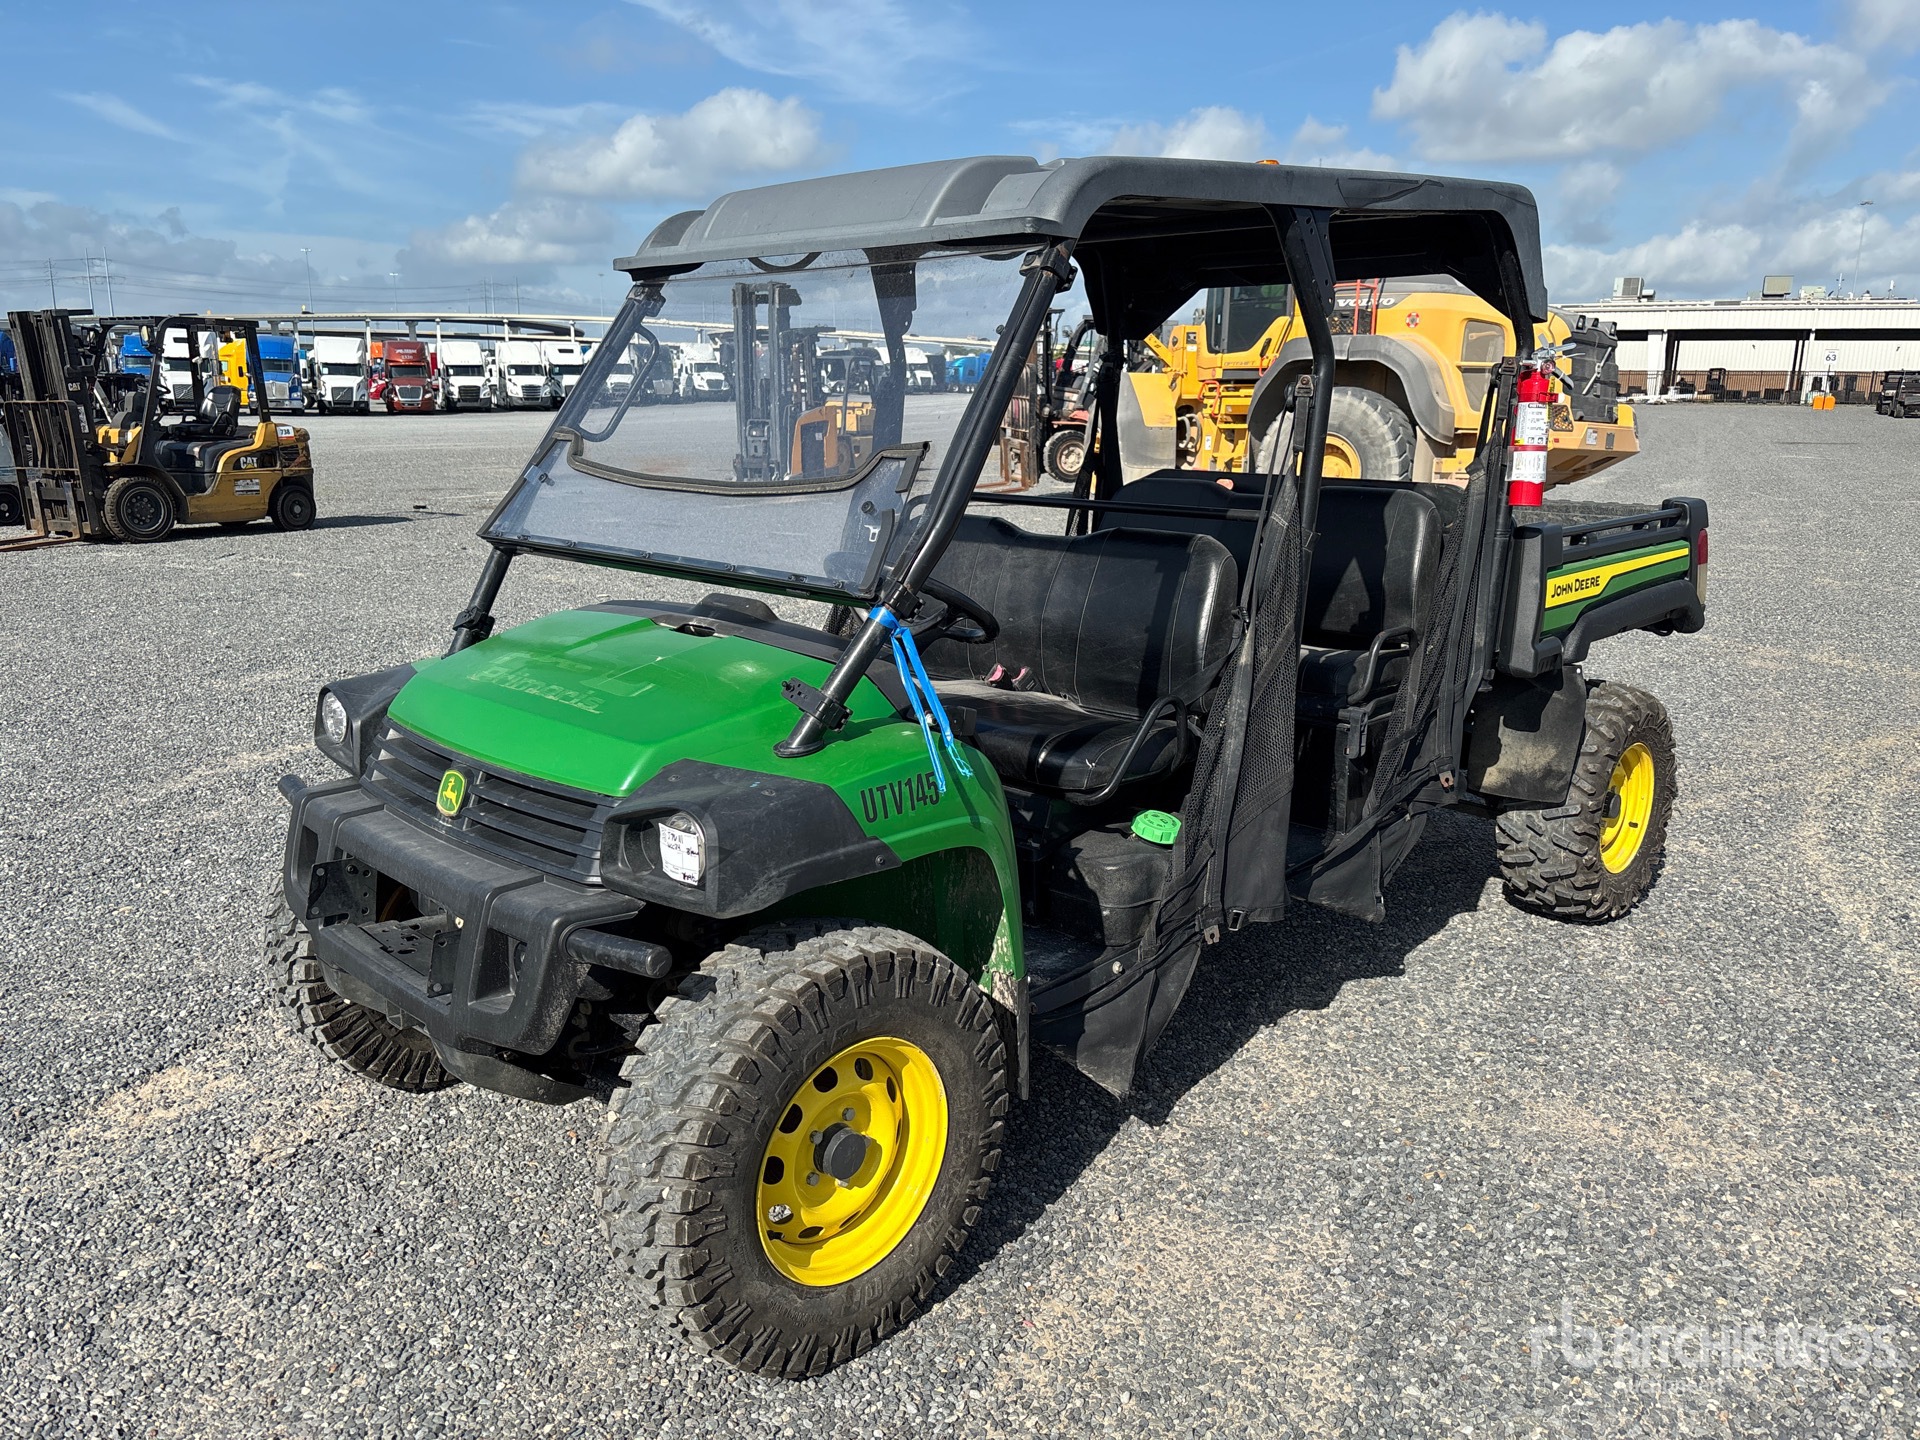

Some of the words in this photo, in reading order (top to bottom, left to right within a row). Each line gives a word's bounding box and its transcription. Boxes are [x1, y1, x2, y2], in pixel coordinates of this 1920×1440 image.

[67, 382, 81, 392] CAT
[279, 428, 291, 436] 738
[240, 456, 258, 469] CAT
[1551, 582, 1574, 598] JOHN
[1574, 575, 1601, 592] DEERE
[860, 771, 940, 823] UTV145
